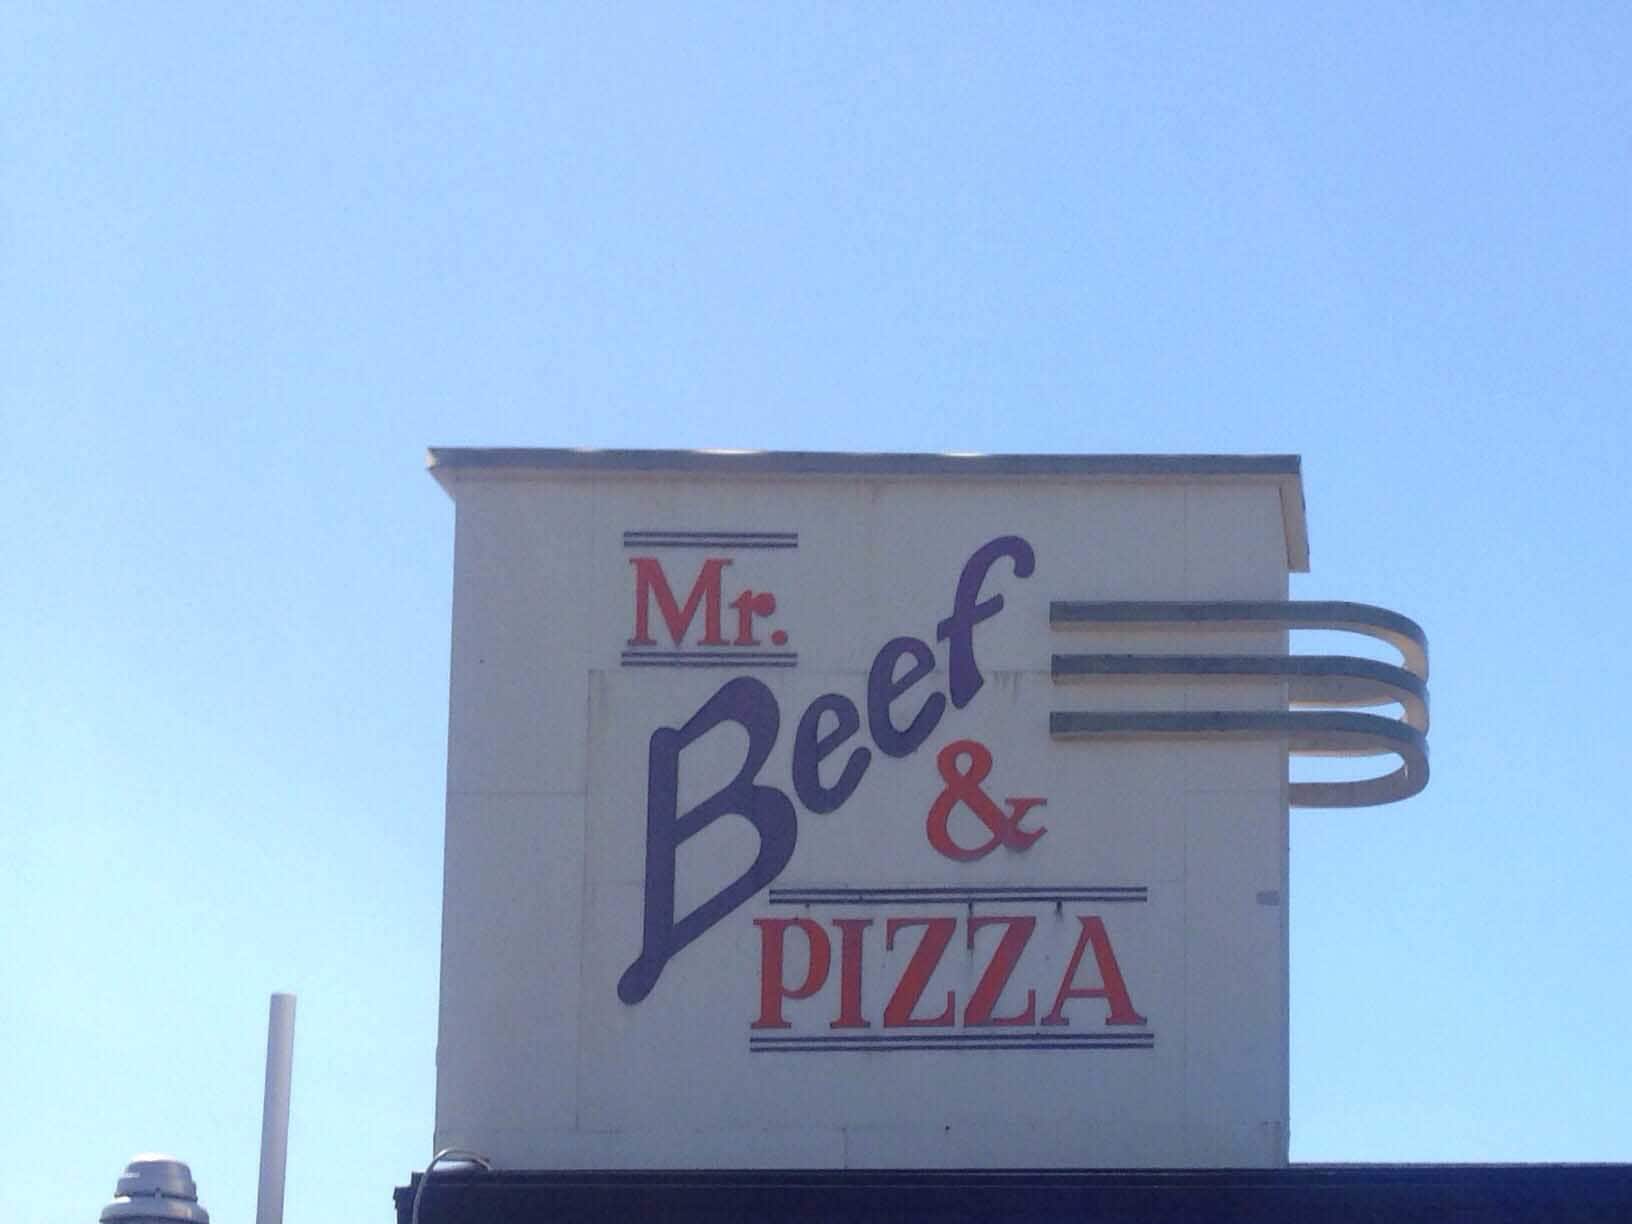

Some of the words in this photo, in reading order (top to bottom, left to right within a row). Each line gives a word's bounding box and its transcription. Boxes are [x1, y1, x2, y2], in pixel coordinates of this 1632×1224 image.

[627, 556, 790, 647] Mr.
[616, 535, 1036, 1005] Beef
[926, 739, 1049, 863] &
[750, 914, 1148, 1030] PIZZA
